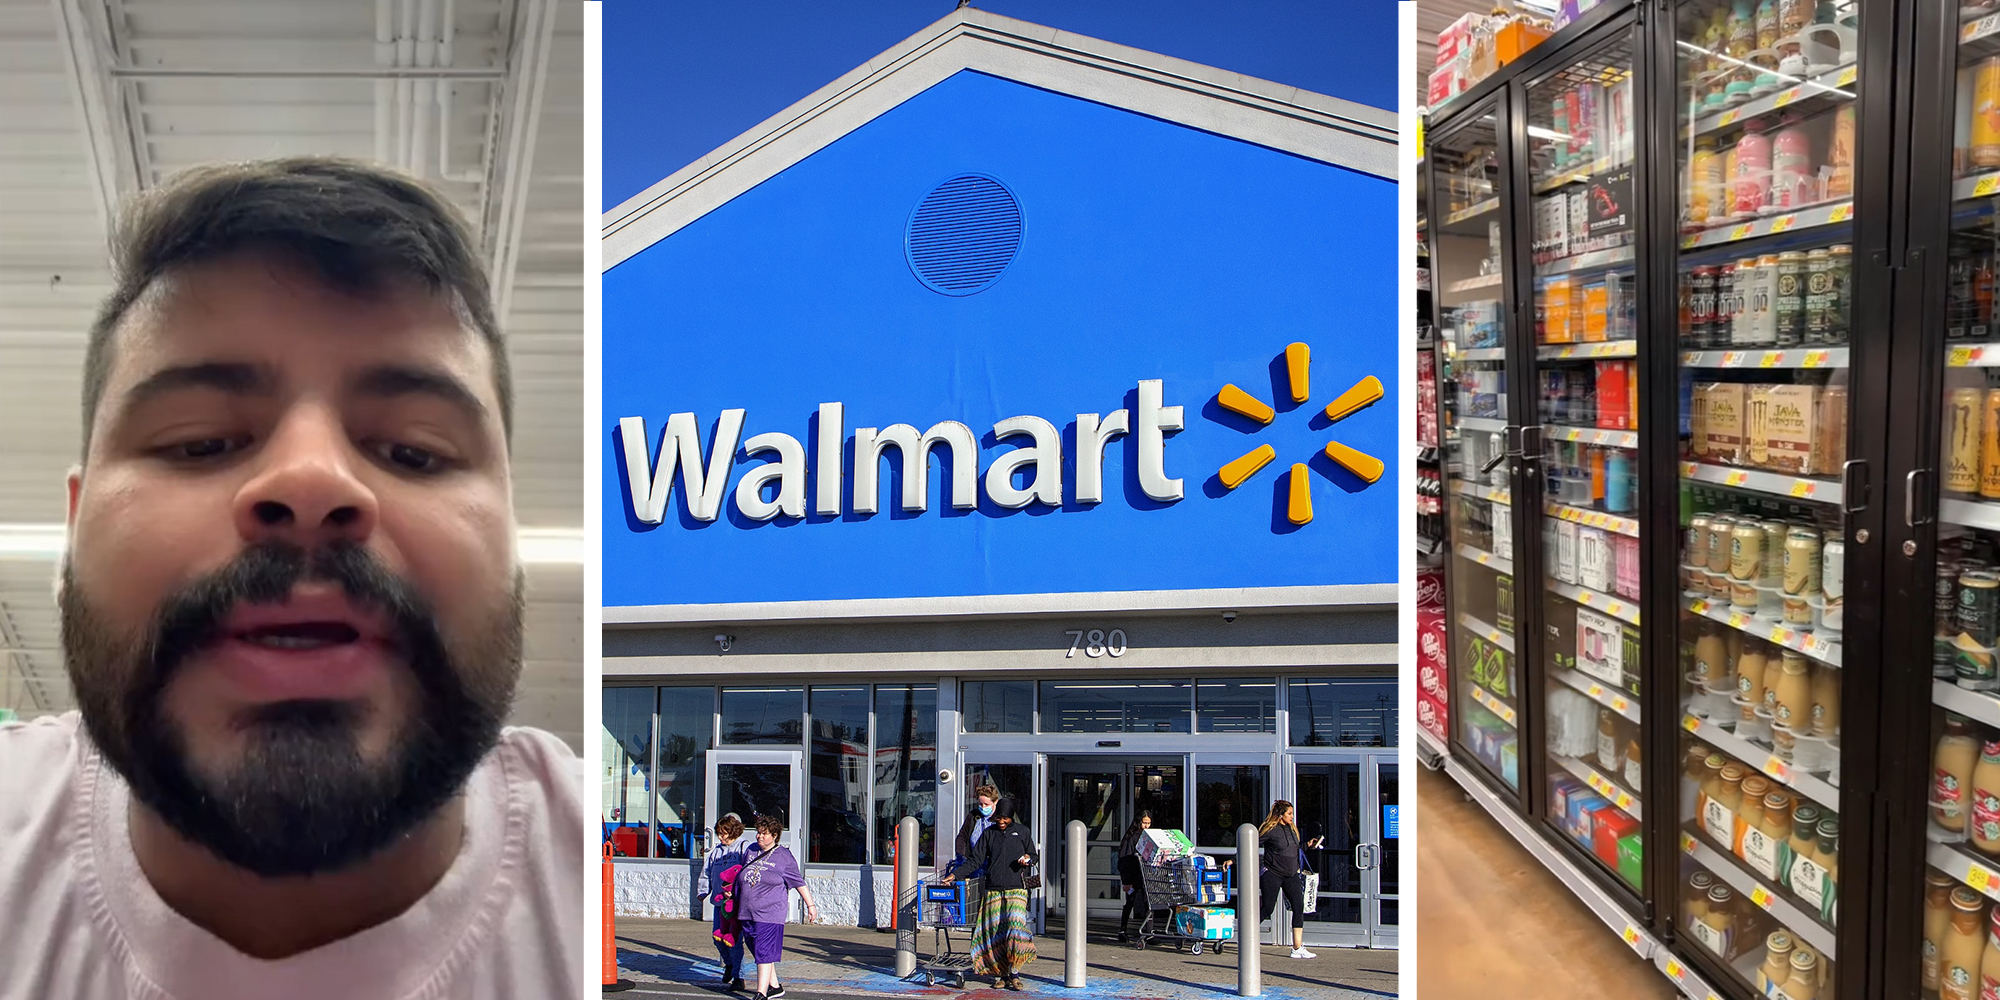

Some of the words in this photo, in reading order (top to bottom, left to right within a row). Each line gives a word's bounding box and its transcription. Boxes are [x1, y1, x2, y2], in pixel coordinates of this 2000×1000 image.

[1773, 402, 1801, 417] JAVA
[619, 379, 1185, 524] Walmart
[1065, 629, 1127, 657] 780
